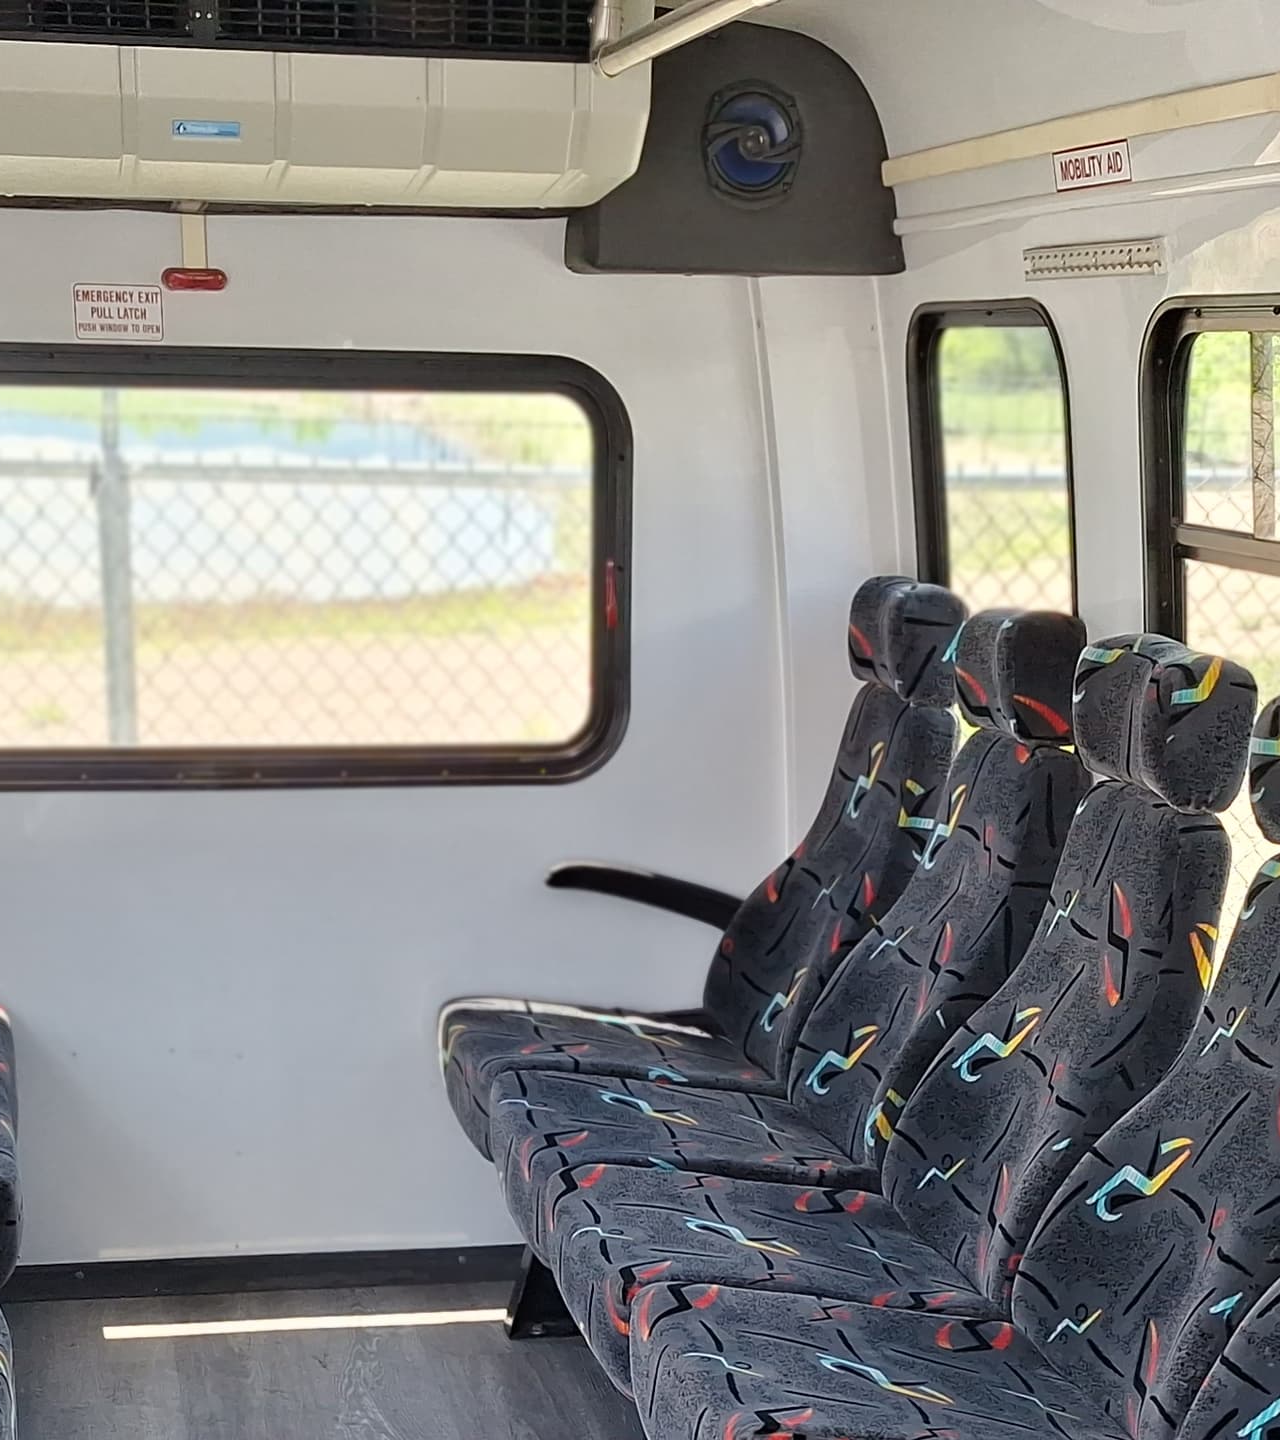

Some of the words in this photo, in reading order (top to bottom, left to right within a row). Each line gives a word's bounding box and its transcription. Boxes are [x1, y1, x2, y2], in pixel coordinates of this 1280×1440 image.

[1060, 154, 1103, 182] MOBILITY
[1107, 151, 1123, 174] AID
[75, 289, 135, 304] EMERGENCY
[138, 291, 160, 304] EXIT
[90, 306, 114, 319] PULL
[117, 307, 147, 320] LATCH
[78, 322, 97, 333] PUSH
[99, 323, 129, 333] WINDOW
[131, 323, 140, 333] TO
[142, 324, 161, 334] OPEN
